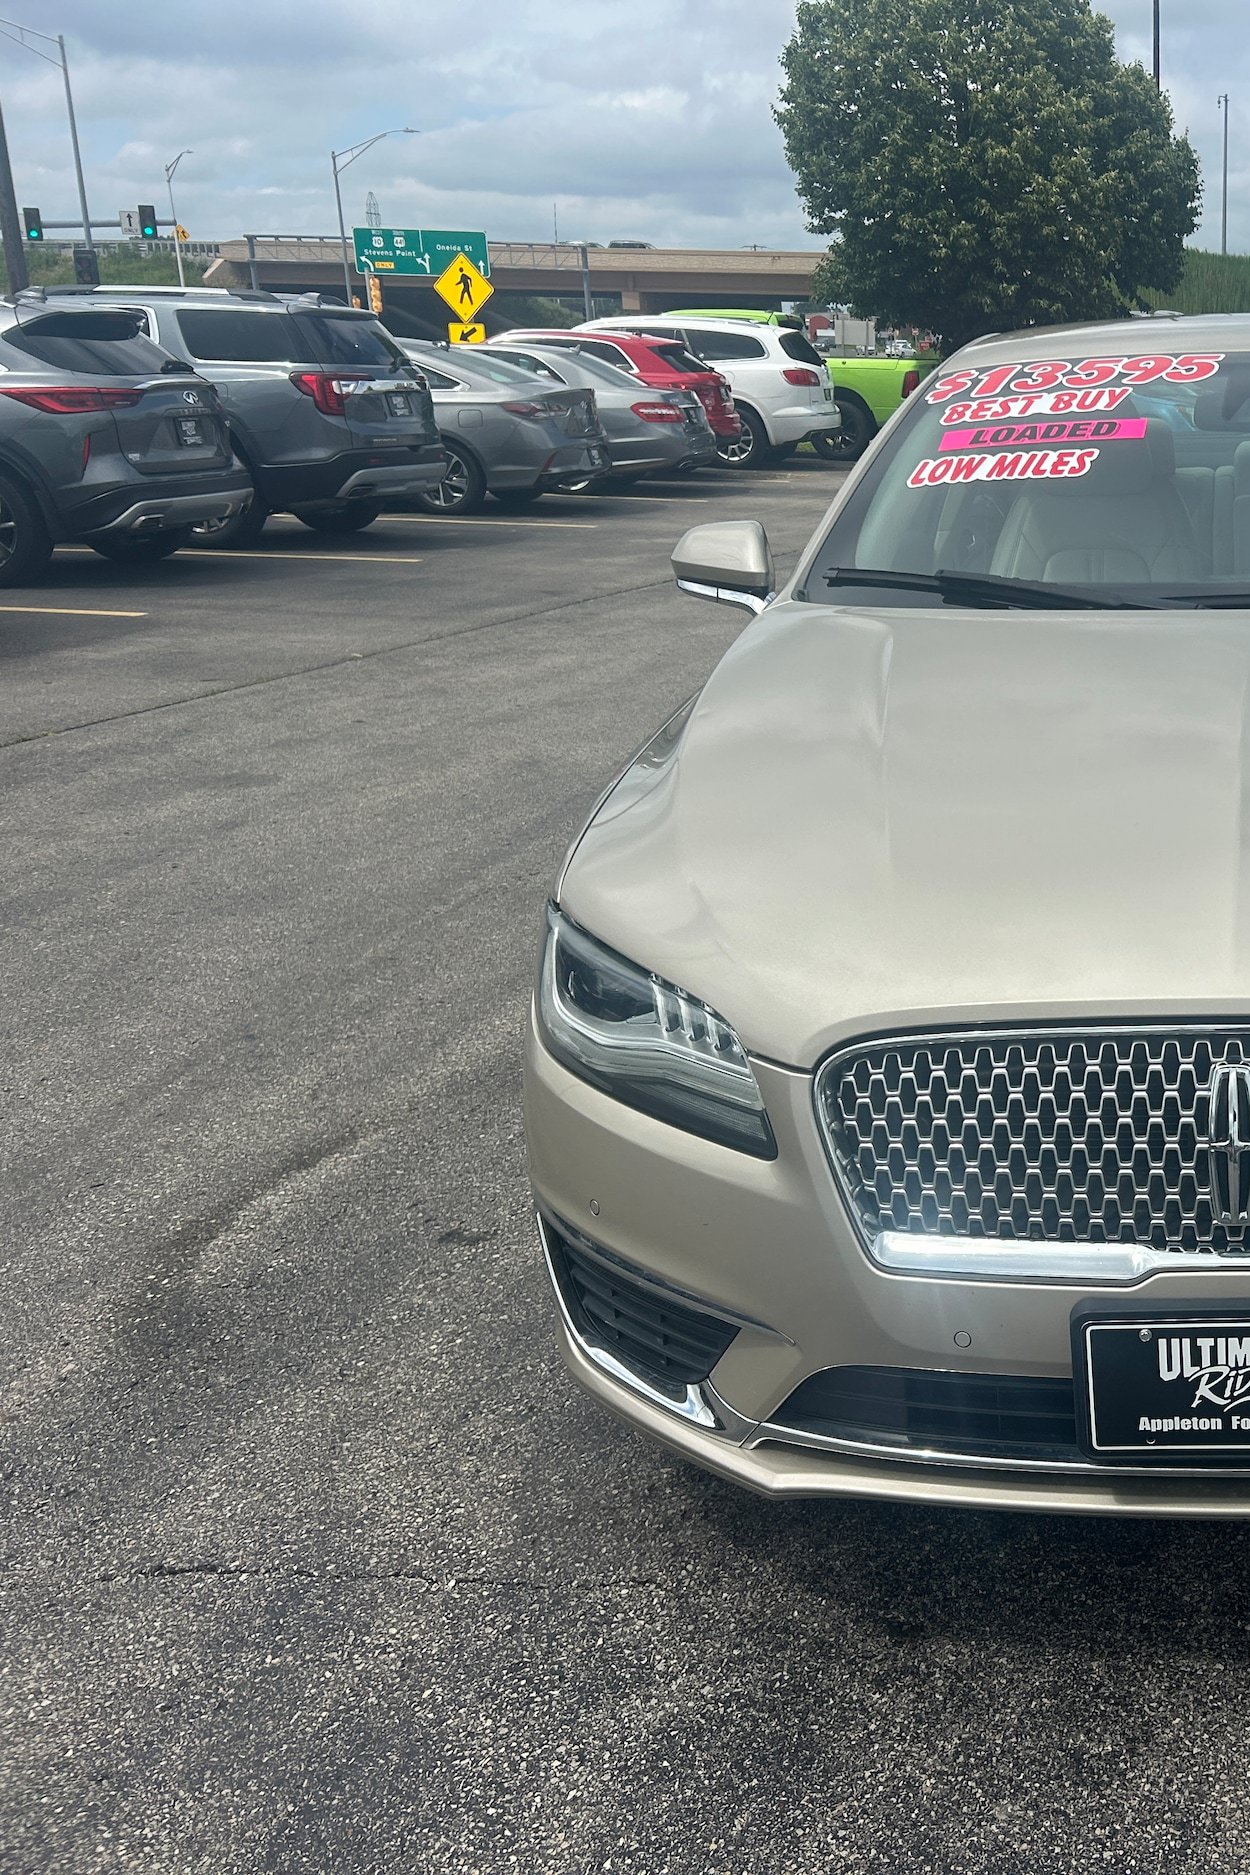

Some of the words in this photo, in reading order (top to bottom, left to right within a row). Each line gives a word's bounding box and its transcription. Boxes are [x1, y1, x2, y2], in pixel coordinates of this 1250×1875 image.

[925, 354, 1225, 404] $13595
[941, 394, 1042, 424] BEST
[1049, 388, 1131, 413] BUY
[968, 421, 1121, 446] LOADED
[908, 455, 986, 487] LOW
[985, 450, 1097, 478] MILES
[1139, 1416, 1222, 1432] Appleton
